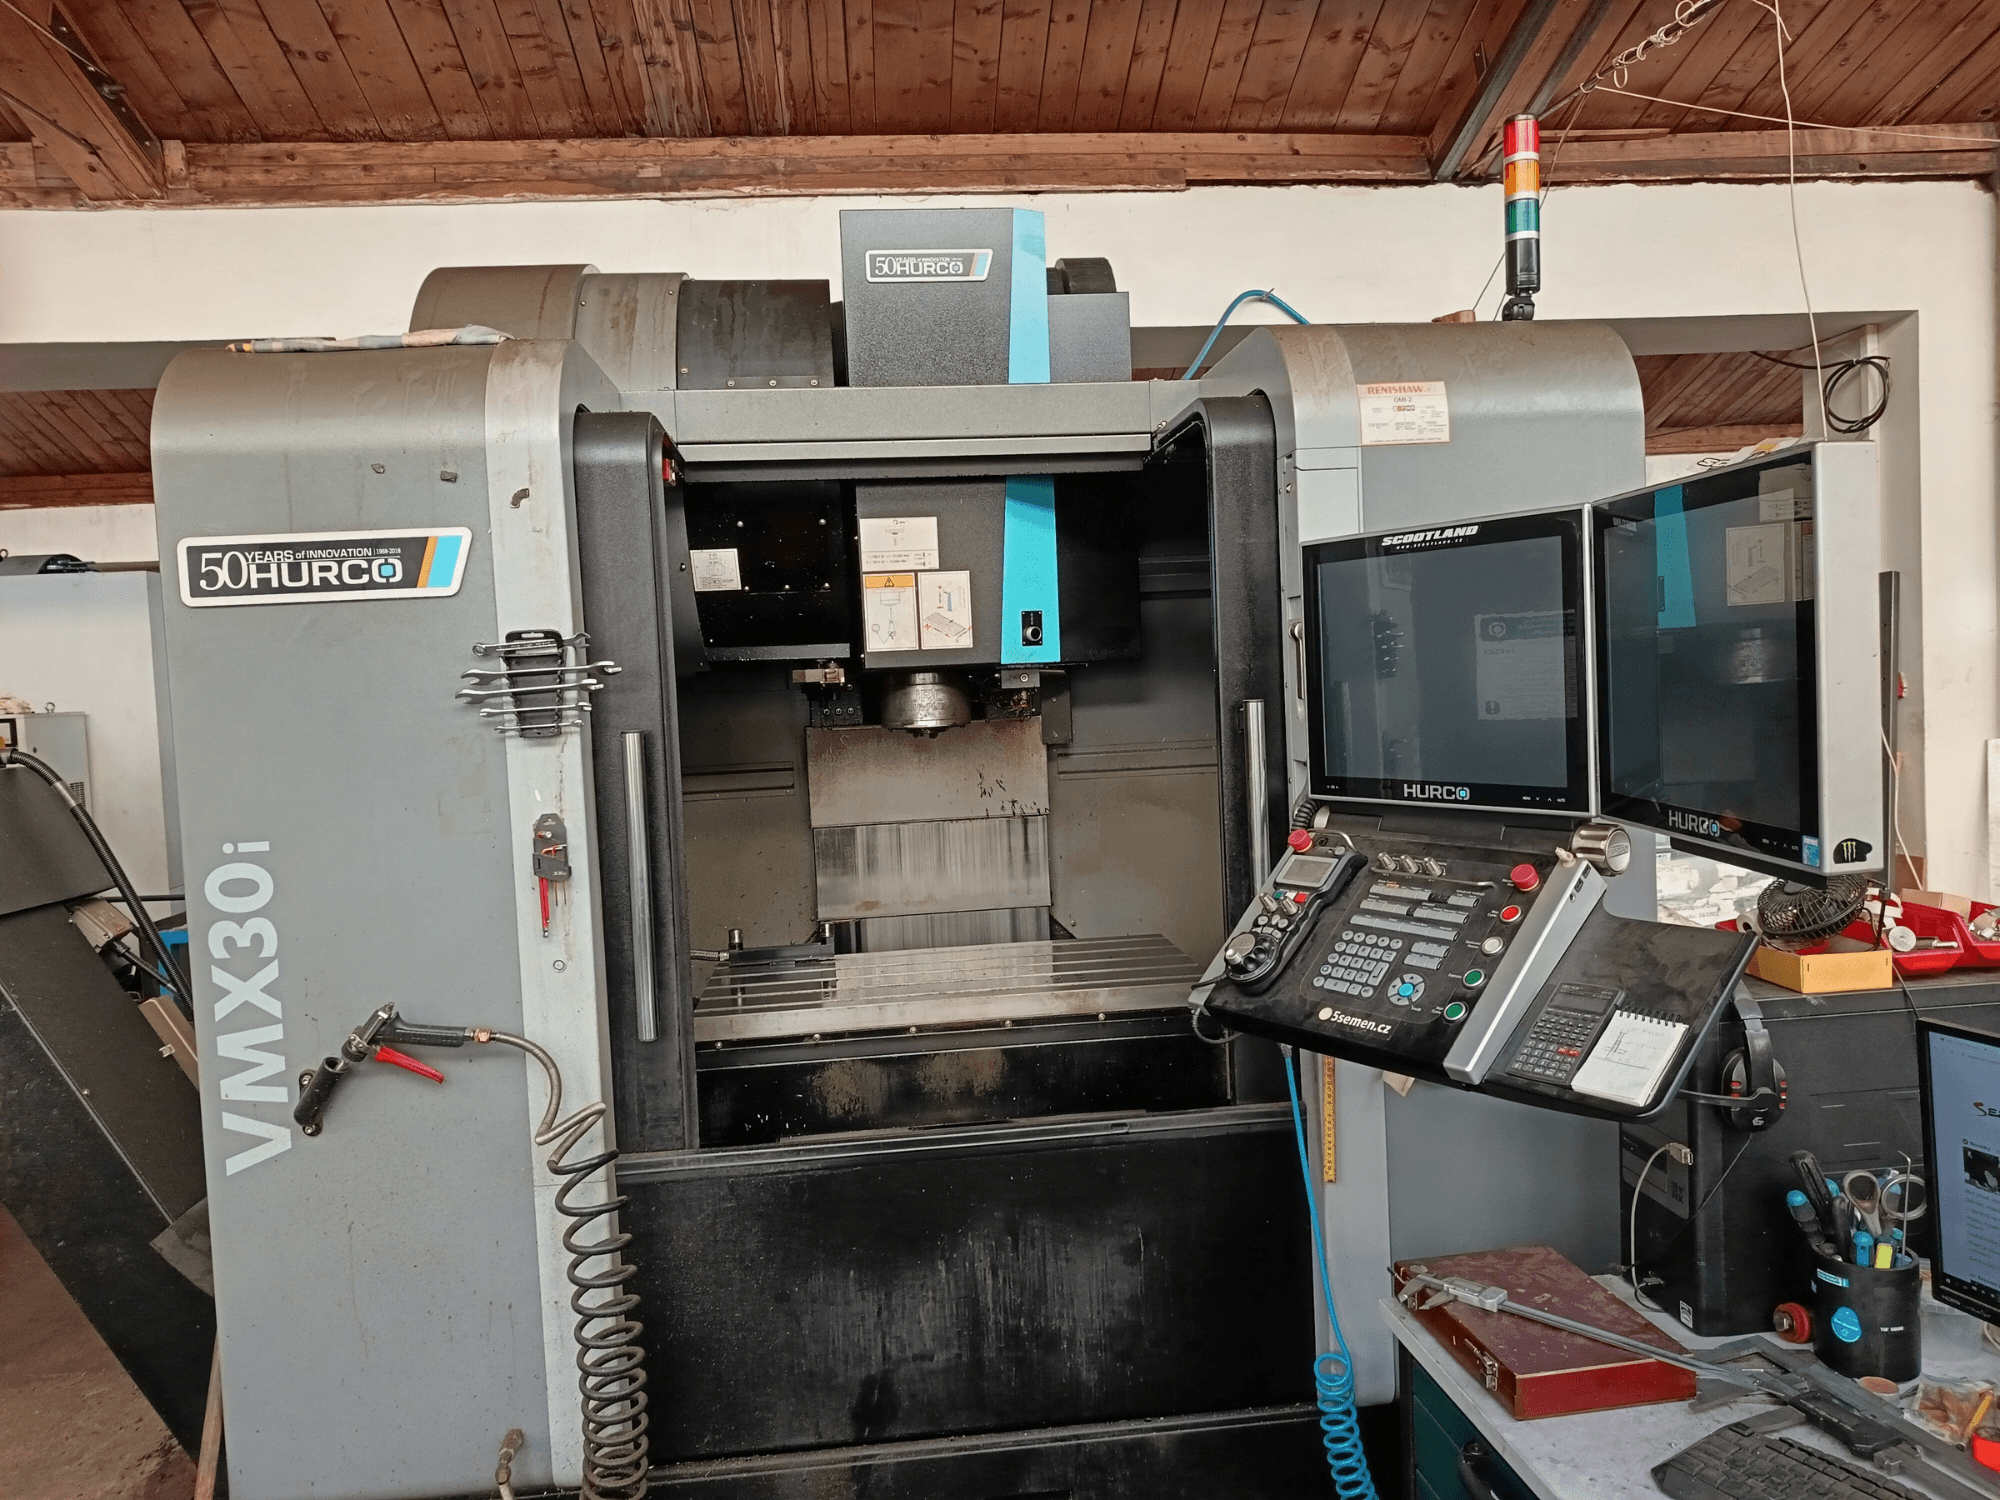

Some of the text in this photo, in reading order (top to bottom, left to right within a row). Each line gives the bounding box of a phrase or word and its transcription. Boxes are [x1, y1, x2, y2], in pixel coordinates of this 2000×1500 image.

[875, 257, 964, 275] 50 HURCO
[1367, 385, 1424, 395] RENISHAW
[1381, 525, 1479, 546] SCOOTLAND
[245, 550, 294, 563] YEARS
[295, 550, 305, 560] of
[306, 547, 372, 559] INNOVATION
[199, 551, 404, 591] 50 HURCO
[1403, 783, 1471, 800] HURCO
[1668, 809, 1721, 838] HURCO
[204, 840, 292, 1177] VMX30i
[1330, 1010, 1392, 1034] 5semen.cz
